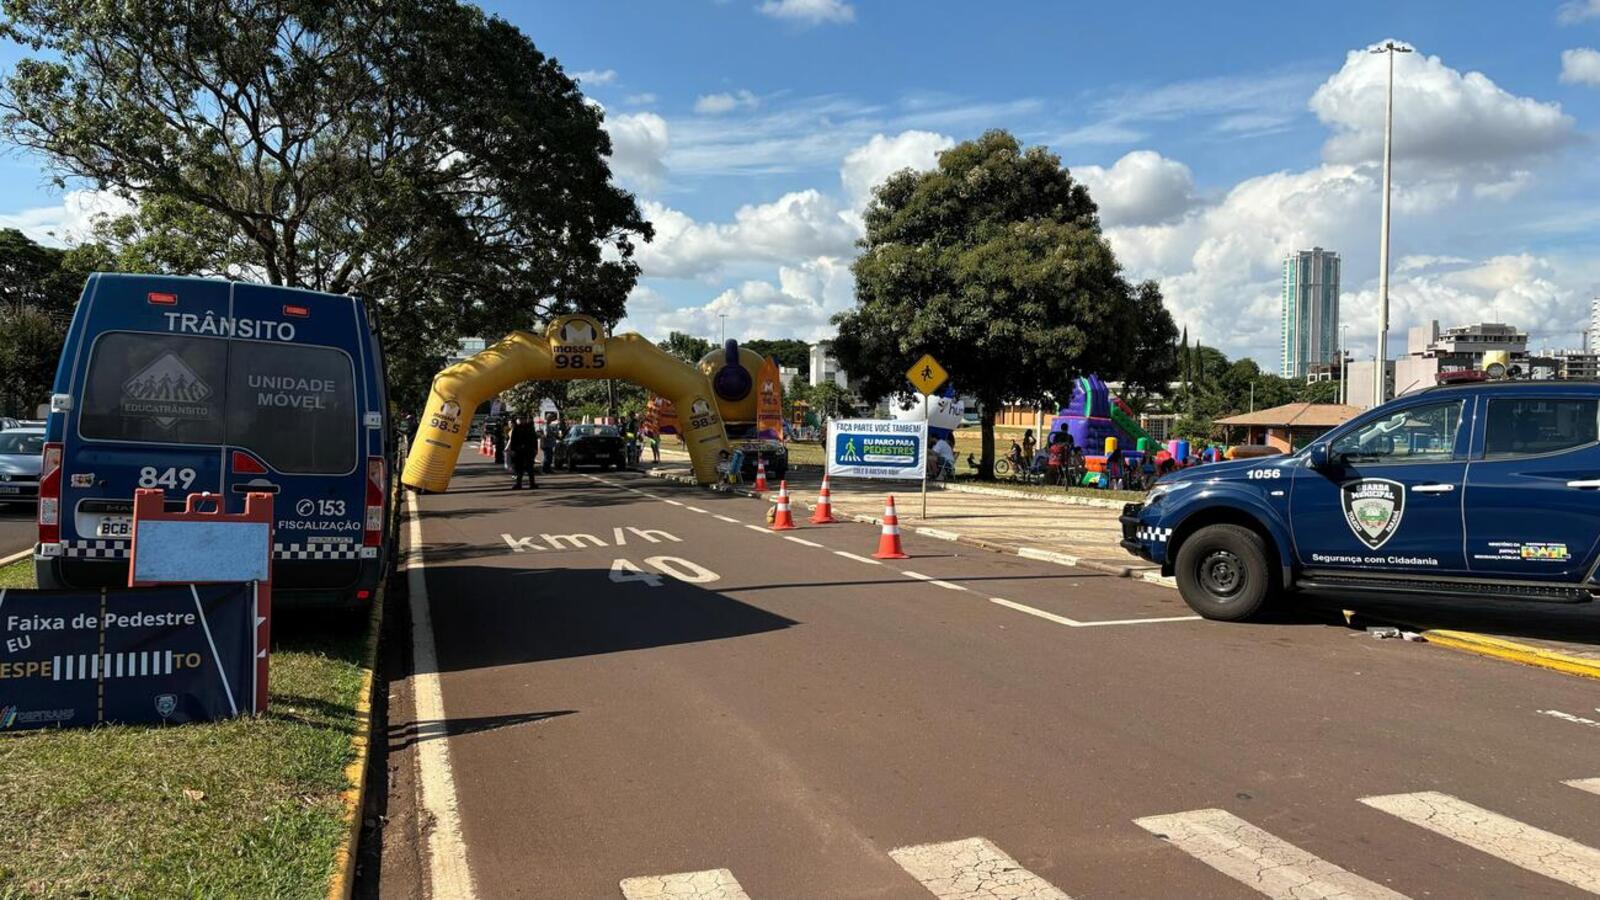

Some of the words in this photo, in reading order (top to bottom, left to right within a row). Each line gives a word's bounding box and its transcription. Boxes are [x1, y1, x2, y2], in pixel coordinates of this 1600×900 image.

[163, 310, 296, 341] TRÂNSITO
[553, 345, 593, 353] massa
[554, 353, 605, 369] 98.5
[248, 374, 336, 393] UNIDADE
[257, 391, 327, 410] MÓVEL
[124, 402, 208, 416] EDUCATRÂNSITO
[431, 418, 461, 434] 98.5
[836, 422, 853, 432] FAÇA
[853, 423, 873, 432] PARTE
[874, 422, 891, 433] VOCÊ
[863, 445, 915, 456] PEDESTRES
[874, 438, 895, 446] PARO
[895, 439, 915, 447] PARA
[138, 466, 197, 491] 849
[1246, 468, 1281, 479] 1056
[1351, 491, 1396, 500] MUNICIPAL
[317, 500, 346, 516] 153
[278, 520, 361, 532] FISCALIZAÇÃO
[501, 526, 684, 553] km/h
[1312, 553, 1362, 564] Segurança
[1387, 556, 1438, 566] Cidadania
[608, 556, 721, 587] 40
[7, 614, 65, 632] Faixa
[72, 613, 98, 629] de
[104, 611, 196, 629] Pedestre
[6, 634, 32, 654] EU
[173, 652, 201, 669] TO
